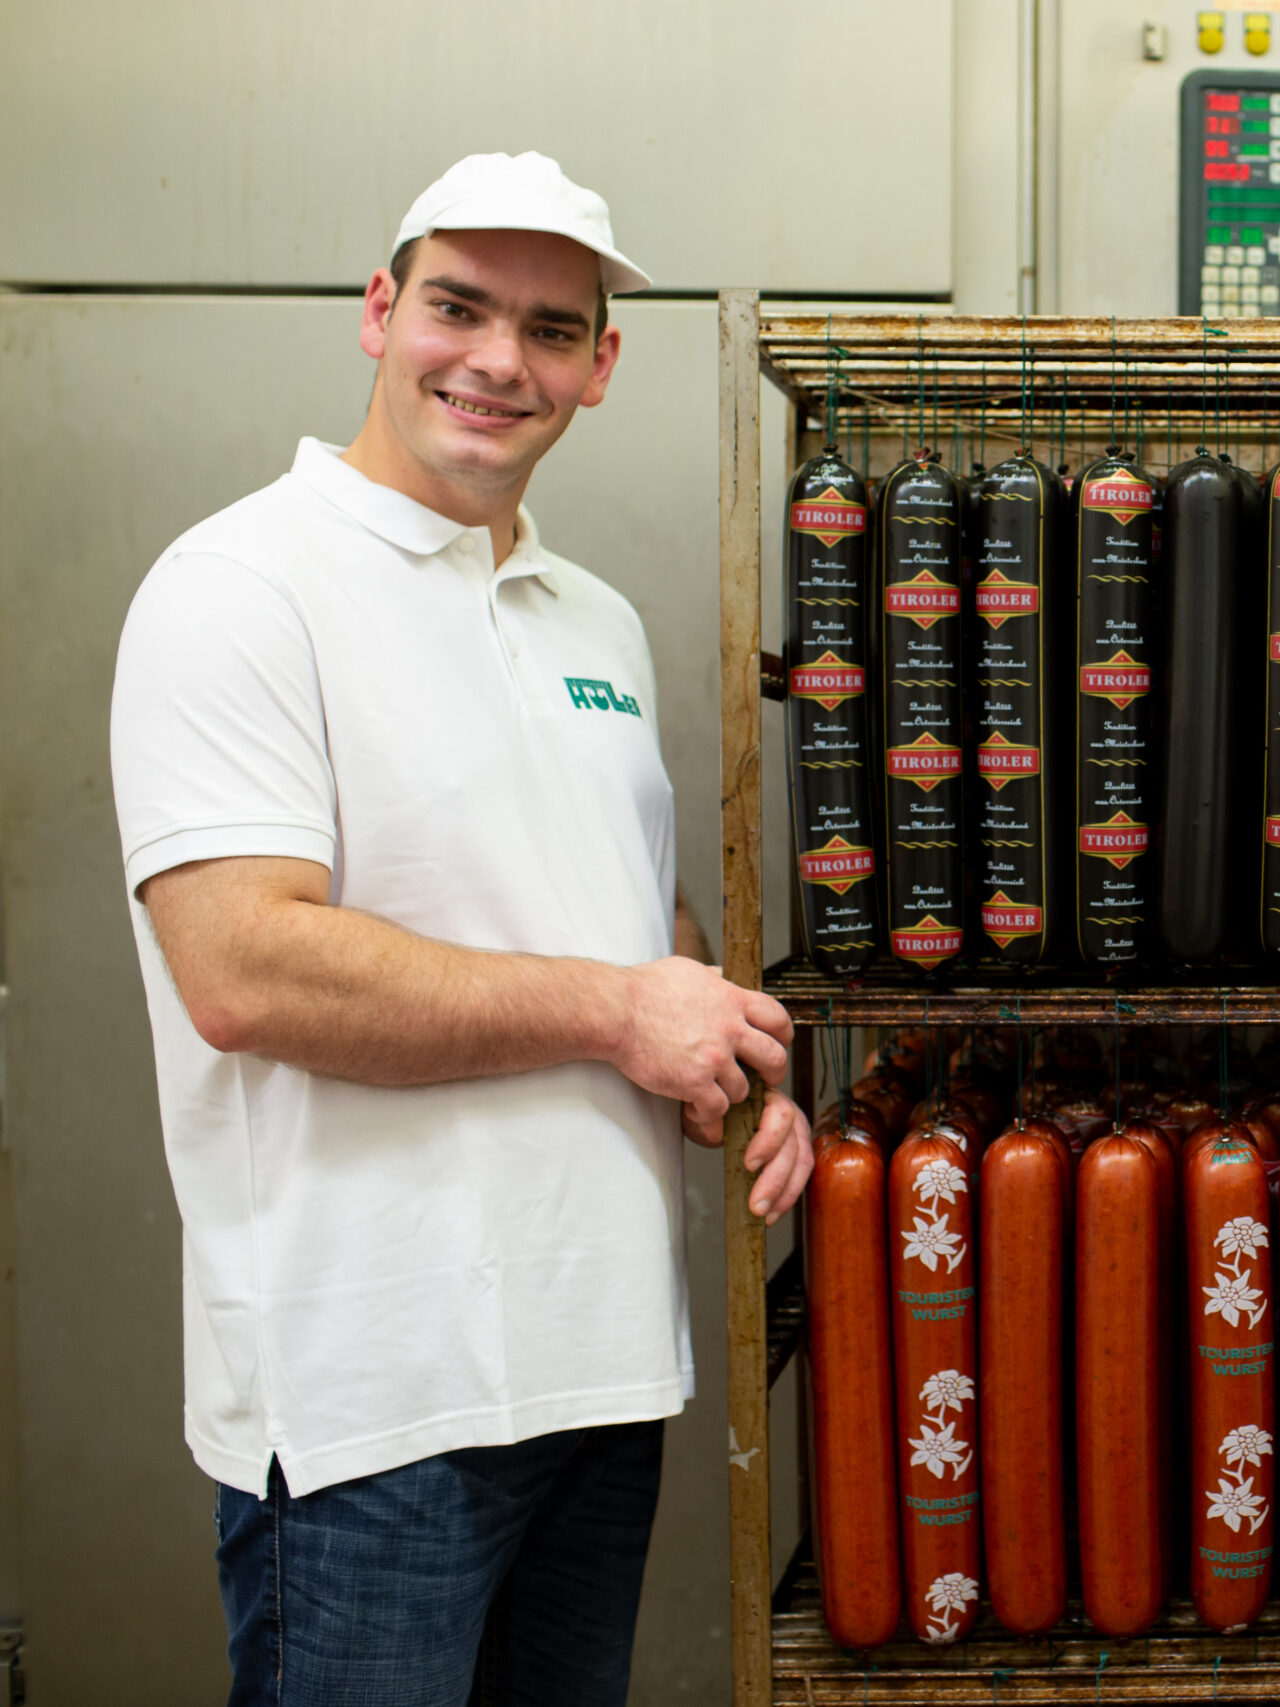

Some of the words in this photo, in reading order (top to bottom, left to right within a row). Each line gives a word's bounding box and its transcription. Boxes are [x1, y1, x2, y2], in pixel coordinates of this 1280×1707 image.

[1089, 488, 1150, 503] TIROLER
[796, 510, 863, 526] TIROLER
[890, 593, 957, 607] TIROLER
[795, 675, 862, 688] TIROLER
[1086, 674, 1148, 686] TIROLER
[892, 756, 959, 769] TIROLER
[1085, 833, 1147, 846] TIROLER
[805, 855, 871, 873] TIROLER
[896, 937, 960, 950] TIROLER
[912, 1306, 966, 1320] WURST
[1213, 1361, 1267, 1375] WURST
[919, 1510, 971, 1525] WURST
[1212, 1565, 1265, 1578] WURST
